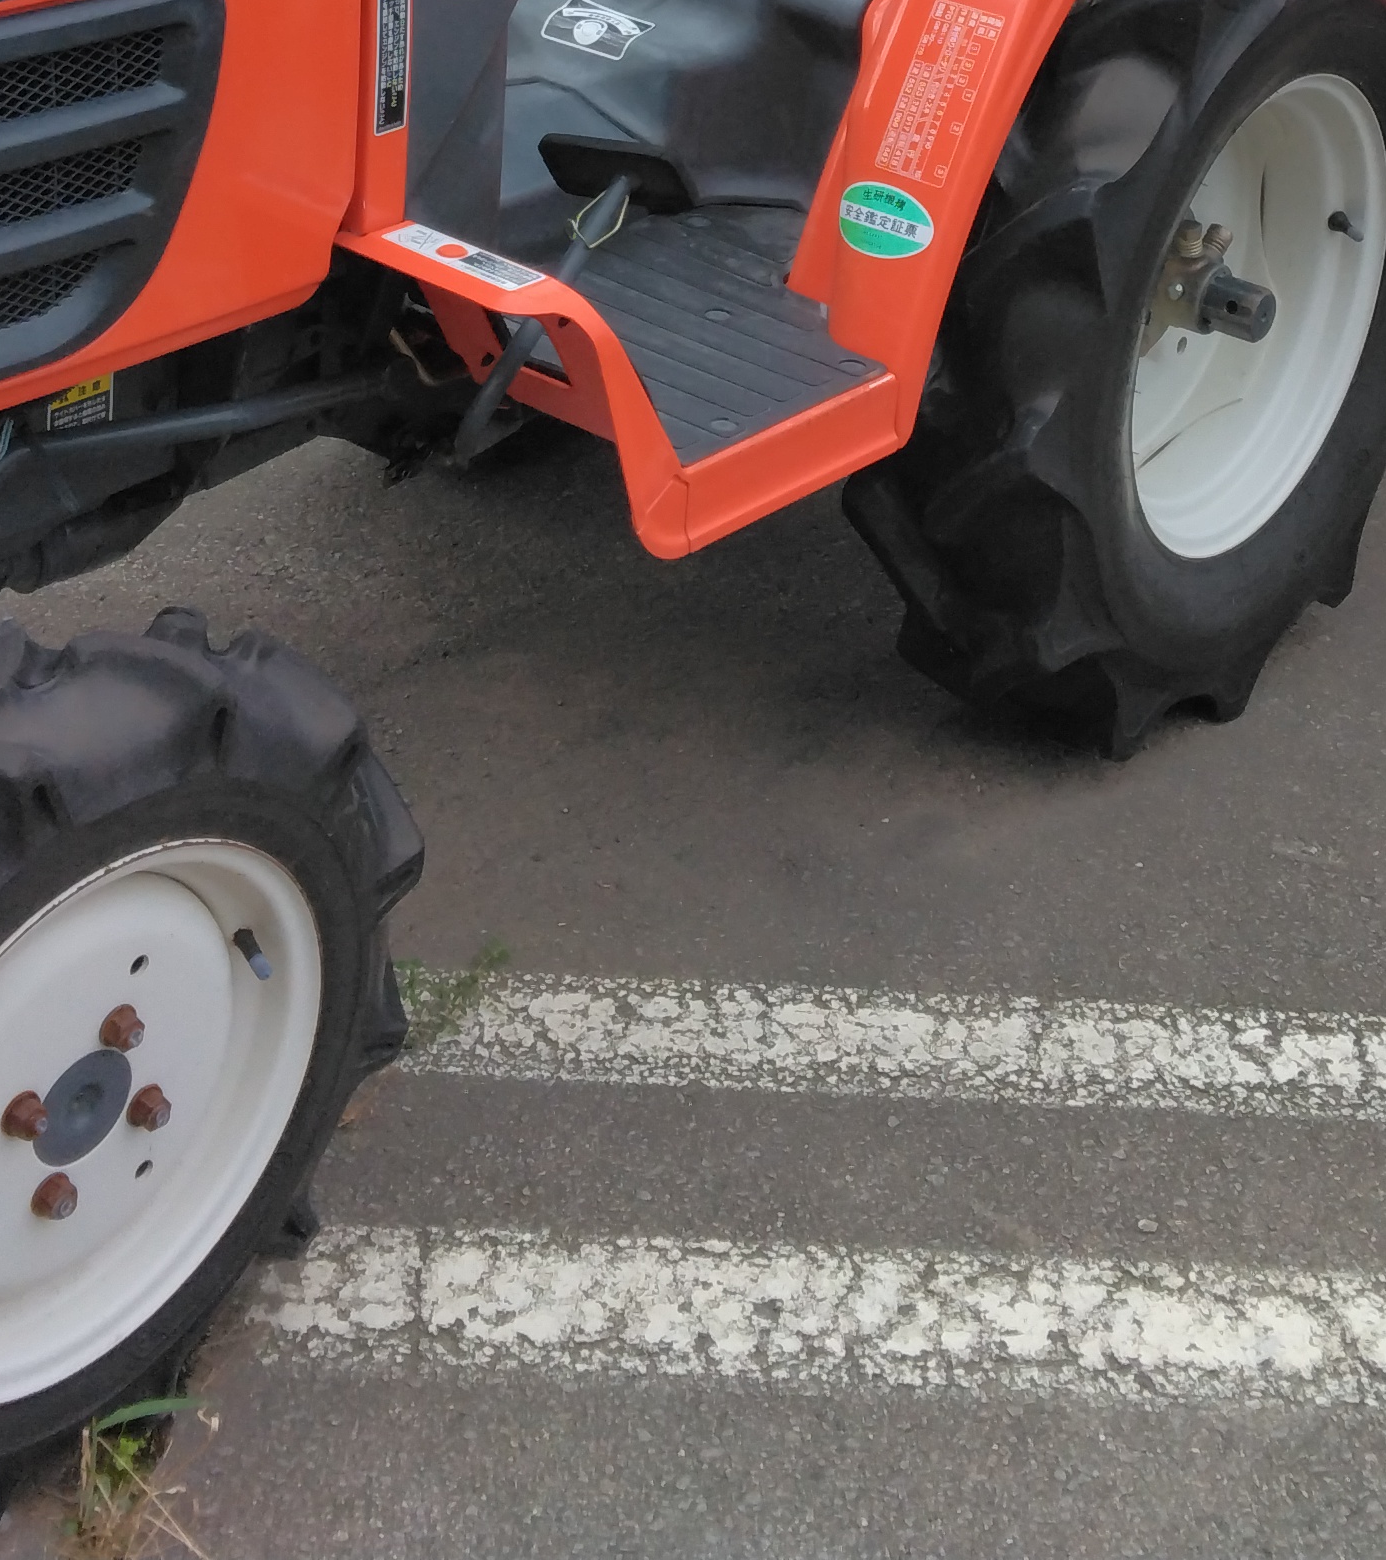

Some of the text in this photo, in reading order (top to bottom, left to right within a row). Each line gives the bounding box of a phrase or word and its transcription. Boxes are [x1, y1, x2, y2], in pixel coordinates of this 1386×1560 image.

[845, 204, 919, 238] 安全鑑定証票
